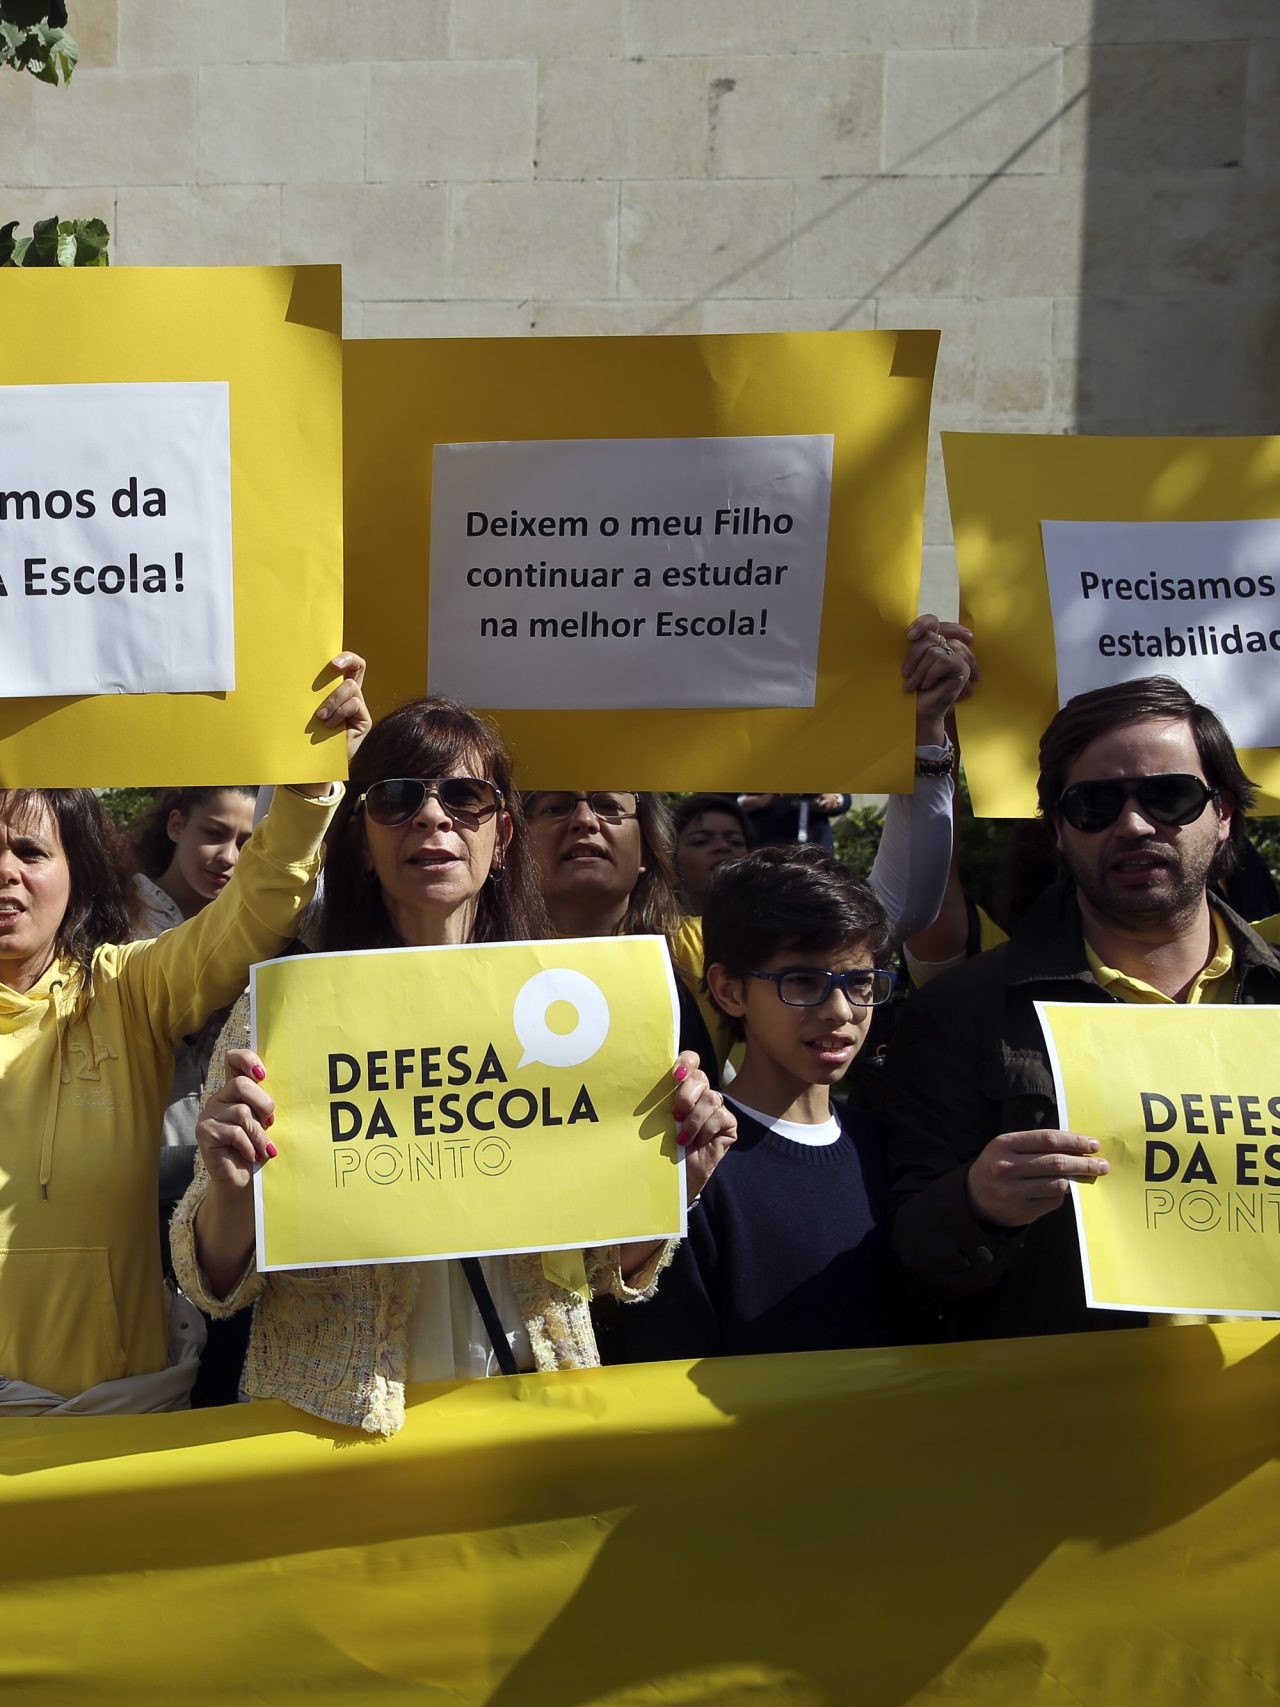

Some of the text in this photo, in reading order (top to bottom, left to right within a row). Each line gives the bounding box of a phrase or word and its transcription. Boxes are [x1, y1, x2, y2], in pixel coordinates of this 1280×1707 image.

[112, 477, 166, 517] da
[467, 507, 793, 536] Deixem o meu Filho
[25, 552, 183, 595] Escola!
[467, 559, 788, 587] continuar a estudar
[1081, 572, 1275, 600] Precisamos
[481, 609, 767, 637] na melhor Escola!
[328, 1042, 507, 1094] DEFESA
[330, 1081, 599, 1142] DA ESCOLA
[333, 1136, 513, 1189] PONTO
[1145, 1141, 1217, 1184] DA
